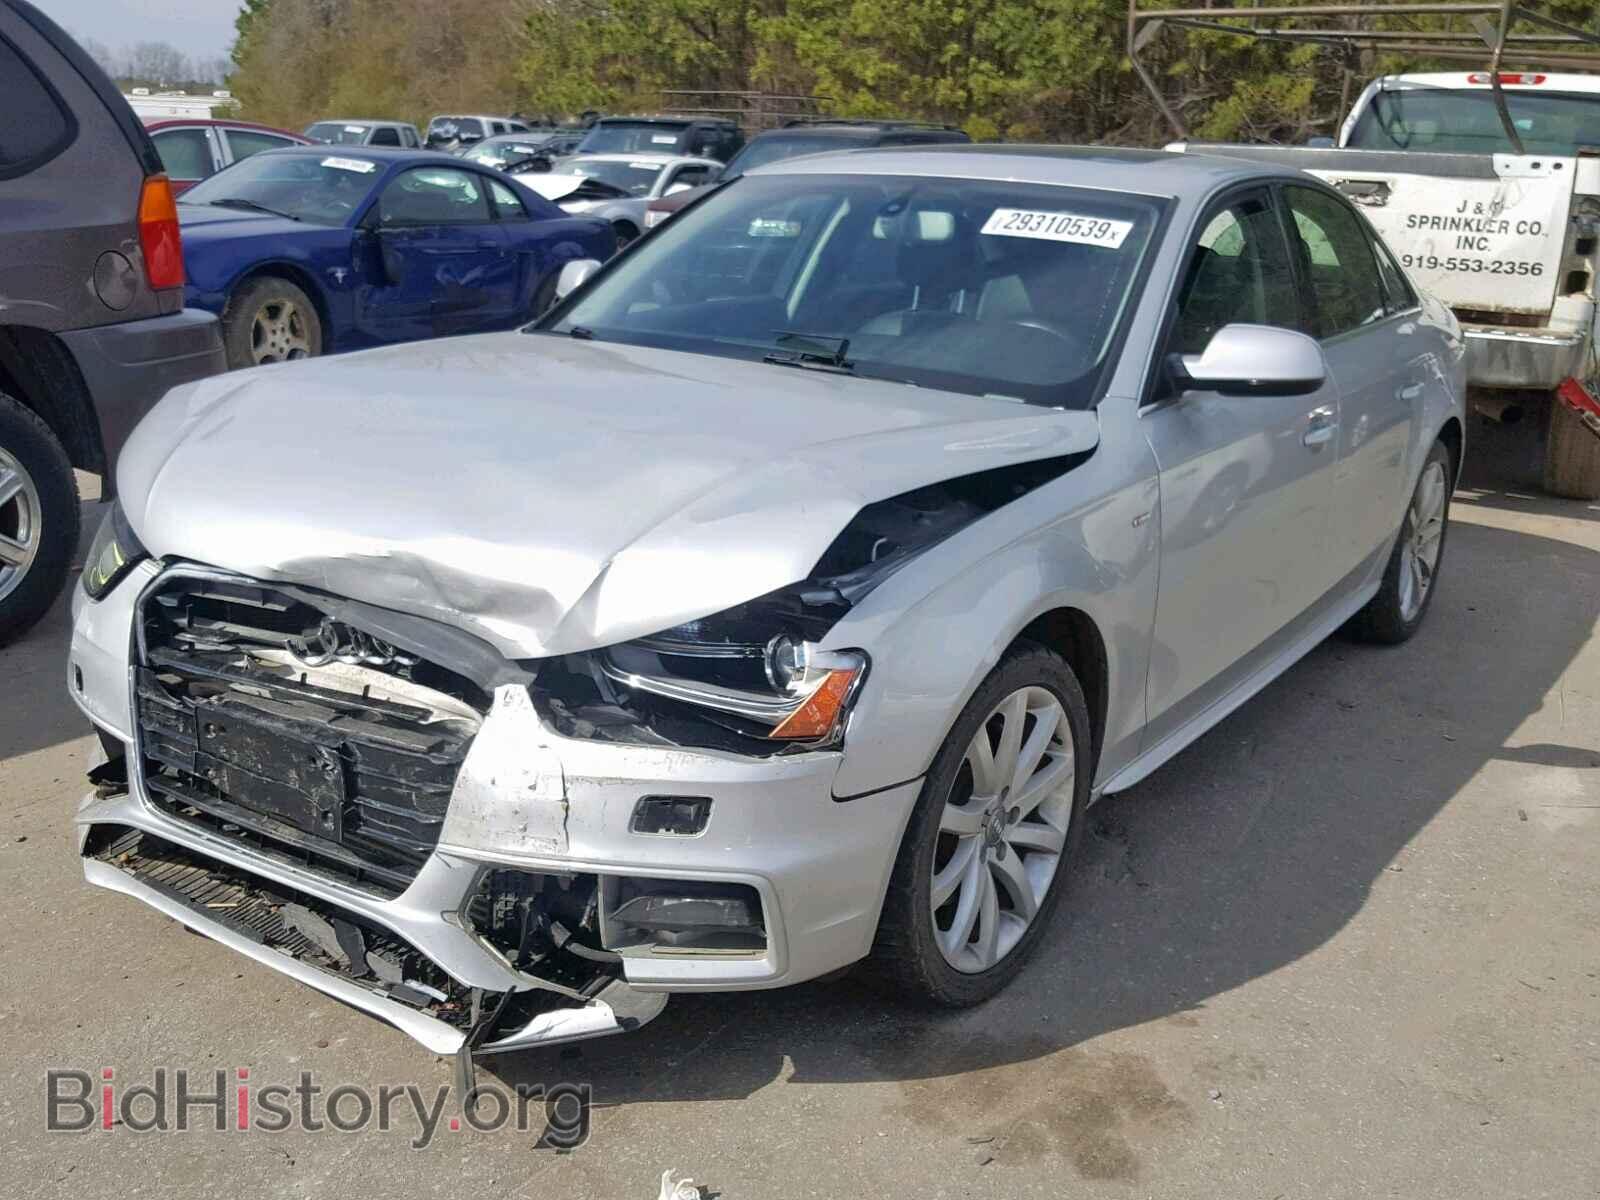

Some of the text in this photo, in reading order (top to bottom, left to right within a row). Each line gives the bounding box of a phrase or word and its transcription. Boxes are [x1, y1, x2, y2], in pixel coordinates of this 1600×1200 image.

[1456, 200, 1467, 213] J
[1473, 202, 1483, 214] &
[1406, 214, 1510, 234] SPRINKLER
[1456, 236, 1491, 251] INC.
[1402, 254, 1544, 276] 919-553-2356
